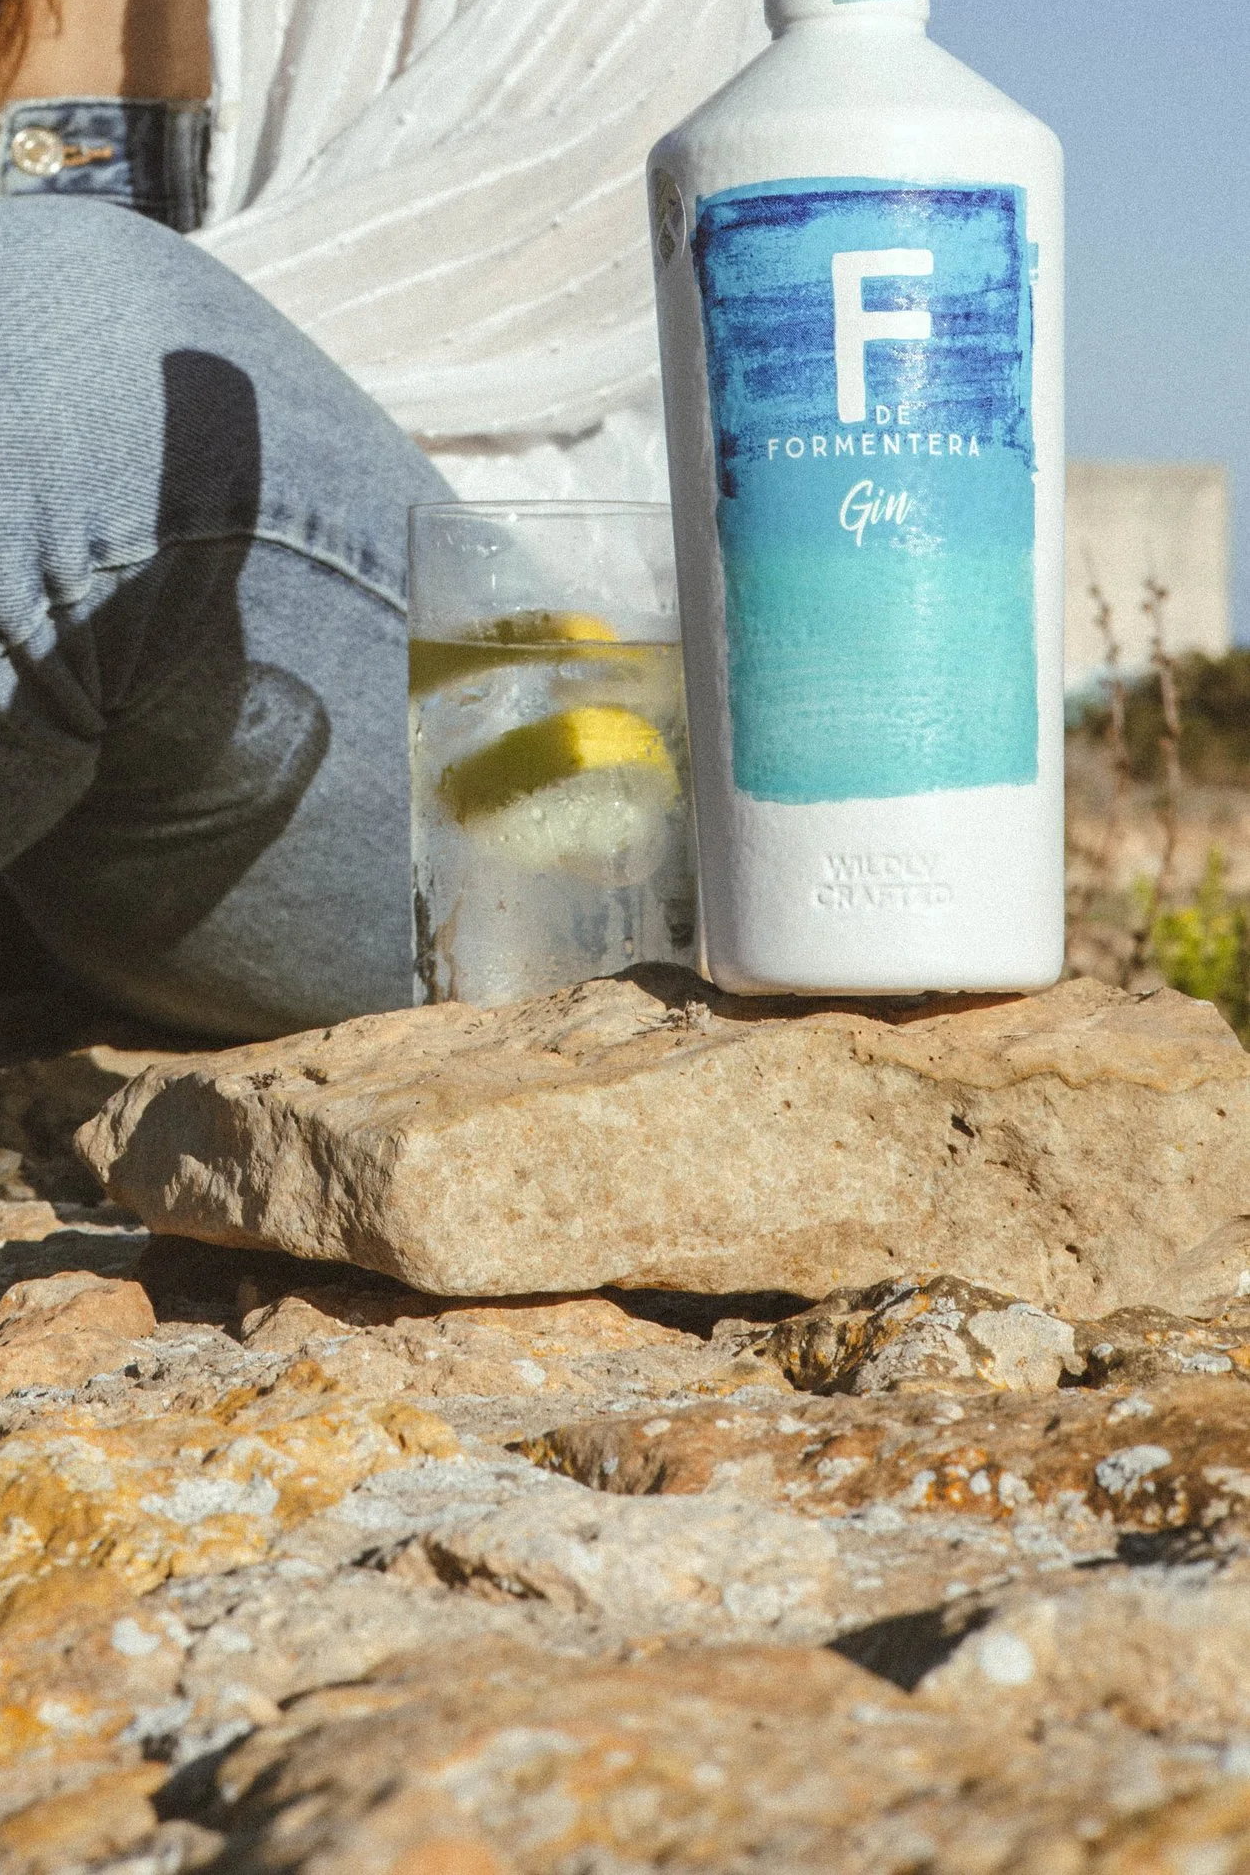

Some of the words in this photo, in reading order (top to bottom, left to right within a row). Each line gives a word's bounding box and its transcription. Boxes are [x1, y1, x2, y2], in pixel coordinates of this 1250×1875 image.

[831, 248, 934, 424] F
[875, 404, 912, 425] DE
[767, 432, 981, 461] FORMENTERA
[839, 479, 913, 548] Gin
